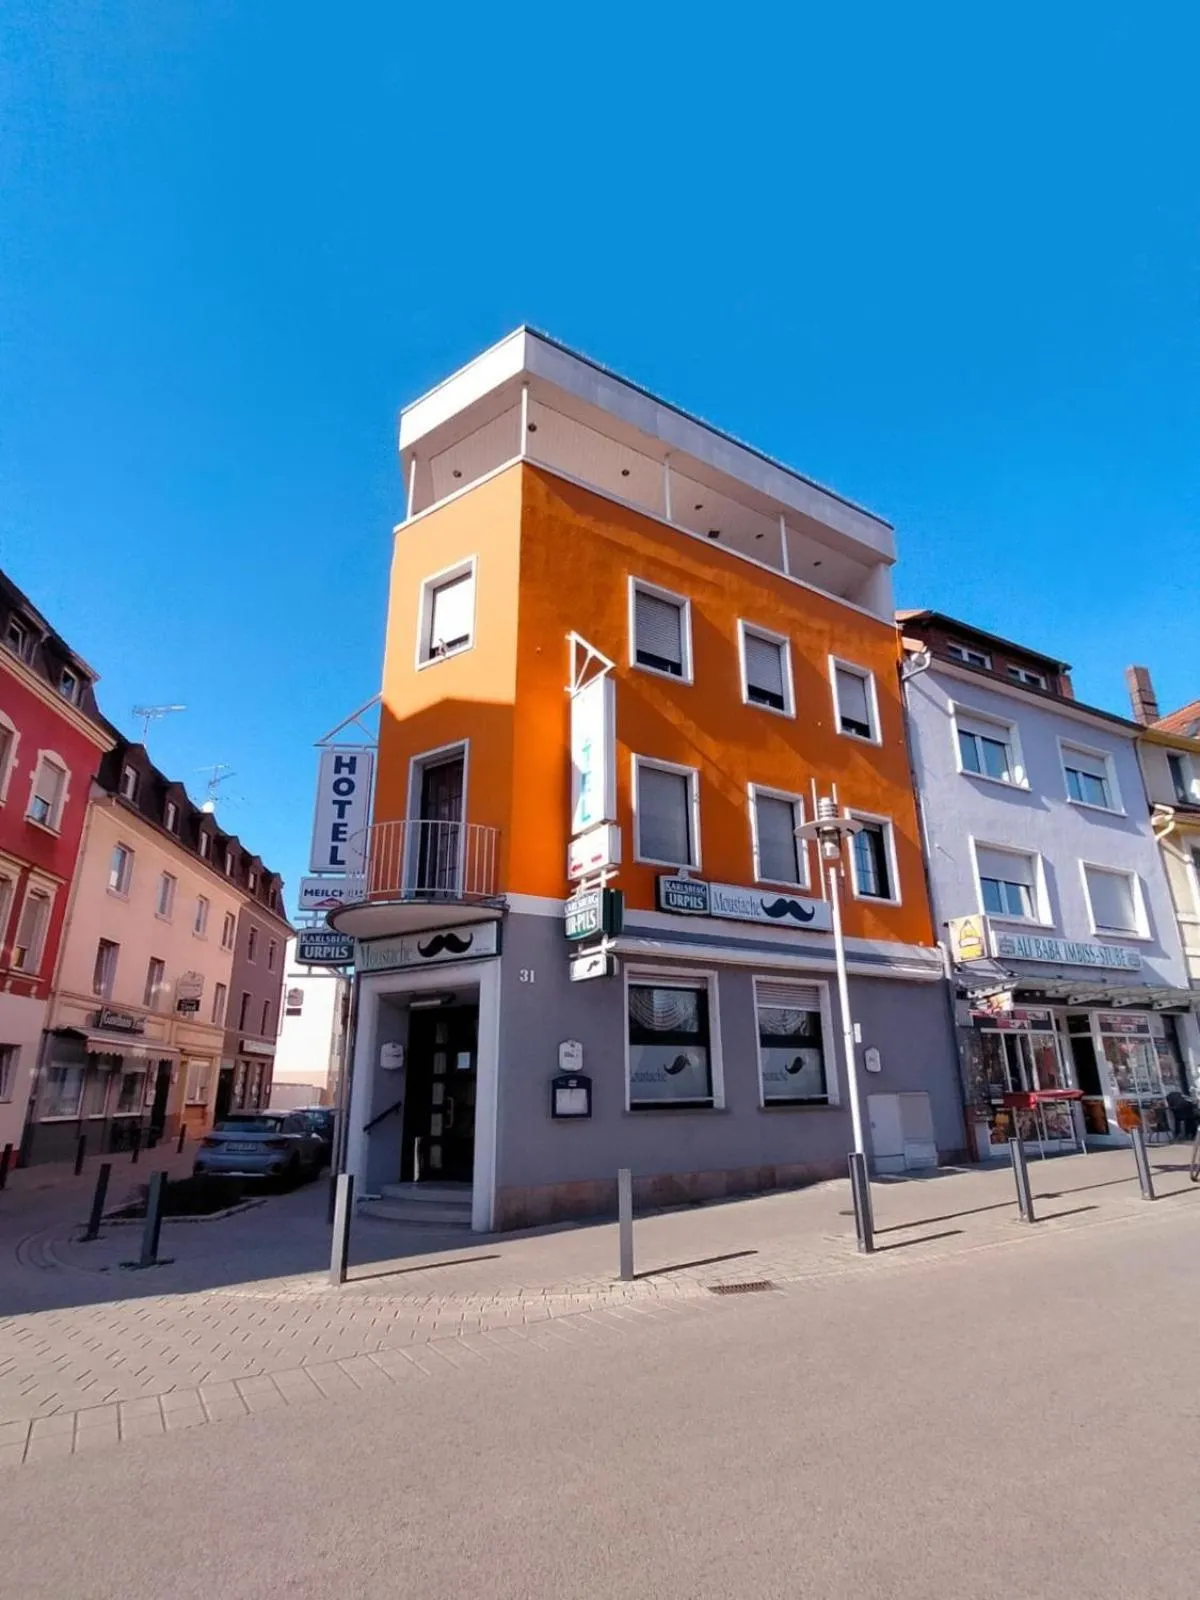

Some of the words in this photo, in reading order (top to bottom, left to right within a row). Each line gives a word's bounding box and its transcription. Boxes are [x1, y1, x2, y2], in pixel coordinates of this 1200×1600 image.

[329, 755, 357, 866] HOTEL
[664, 880, 706, 895] KARLSBERG
[669, 893, 704, 909] URPILS
[304, 945, 349, 959] URPILS
[1015, 936, 1031, 958] ALI
[1035, 940, 1061, 961] BABA
[519, 969, 536, 983] 31
